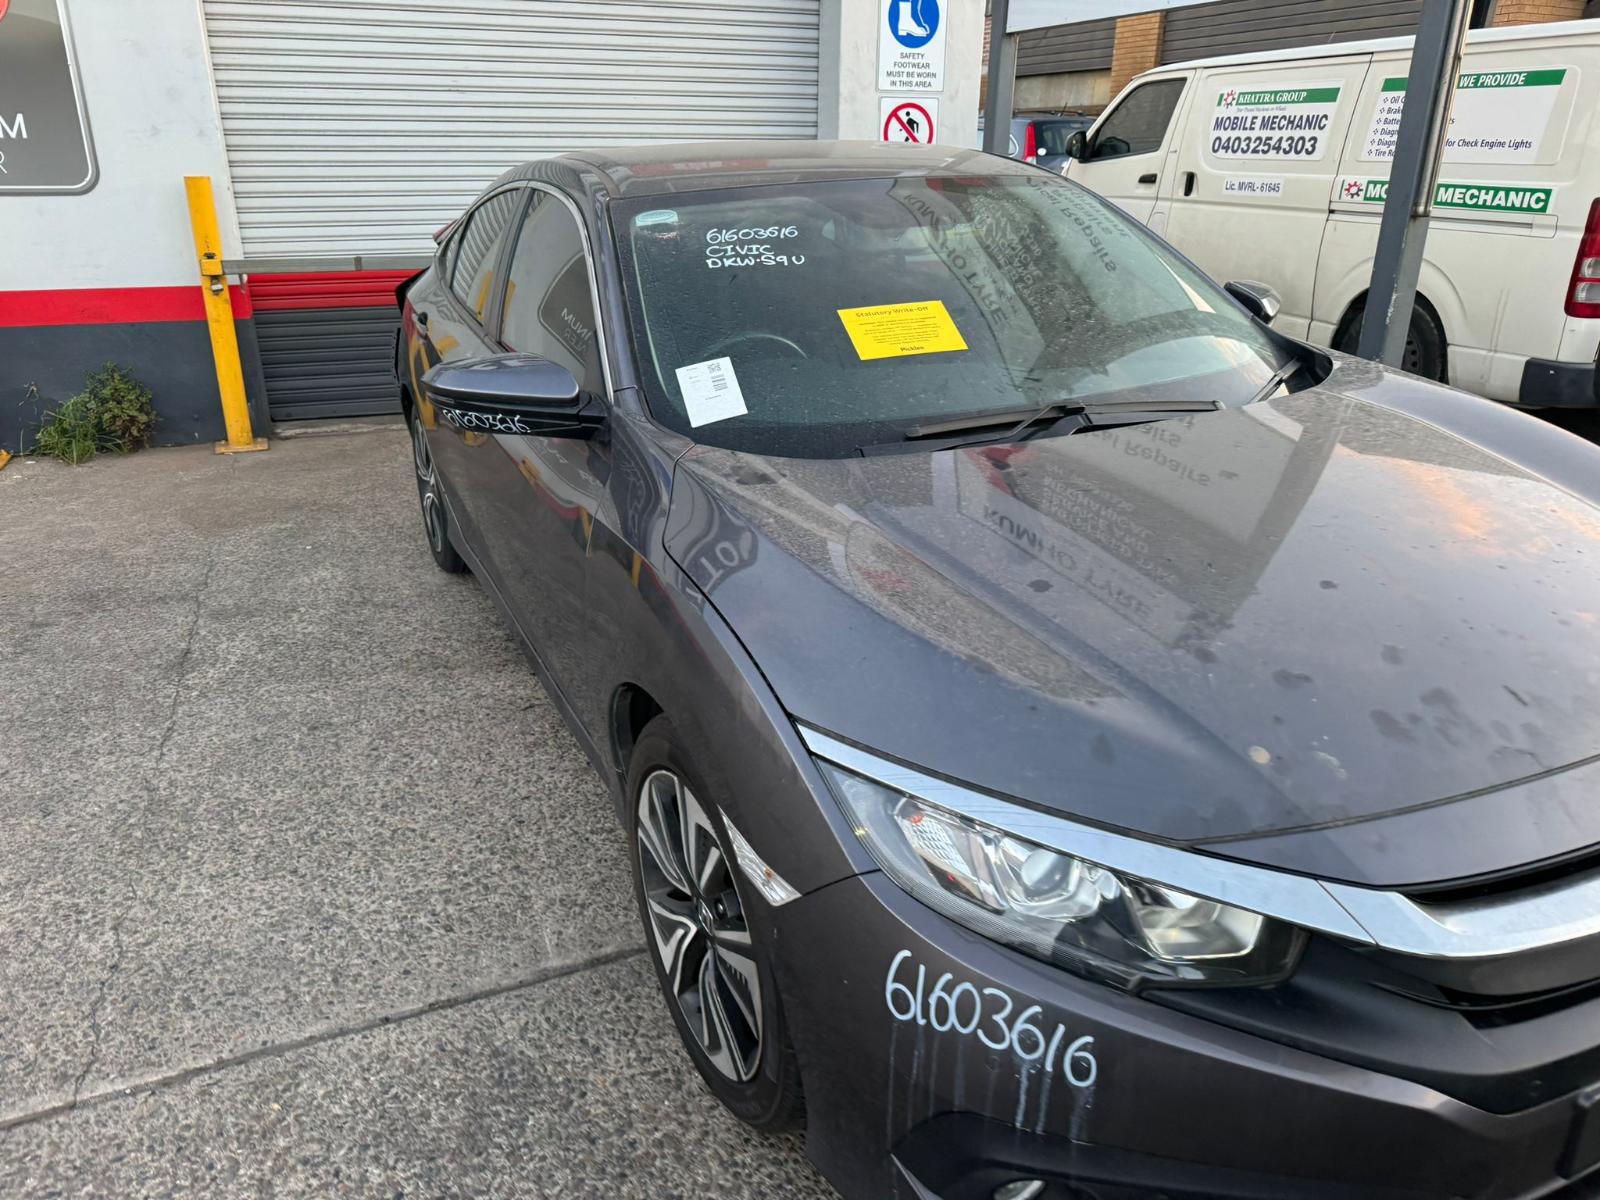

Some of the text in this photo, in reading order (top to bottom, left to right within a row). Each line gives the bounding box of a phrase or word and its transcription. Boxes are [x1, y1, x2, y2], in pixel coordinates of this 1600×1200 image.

[900, 52, 925, 60] SAFETY
[1459, 73, 1527, 88] WE PROVIDE
[1238, 91, 1307, 104] KHATTRA GROUP
[1390, 96, 1401, 104] Oil
[1386, 106, 1402, 115] Brak
[1213, 114, 1329, 131] MOBILE MECHANIC
[1383, 117, 1401, 125] Batte
[1211, 136, 1318, 155] 0403254303
[1377, 138, 1533, 151] Diagn for Check Engine Lights
[1374, 149, 1387, 157] Tire
[1260, 182, 1281, 193] 61645
[1436, 186, 1547, 210] MECHANIC
[706, 225, 799, 244] 61603616
[705, 244, 775, 258] CIVIC
[856, 306, 929, 317] Statutory Write-Off
[886, 949, 1098, 1088] 61603616
